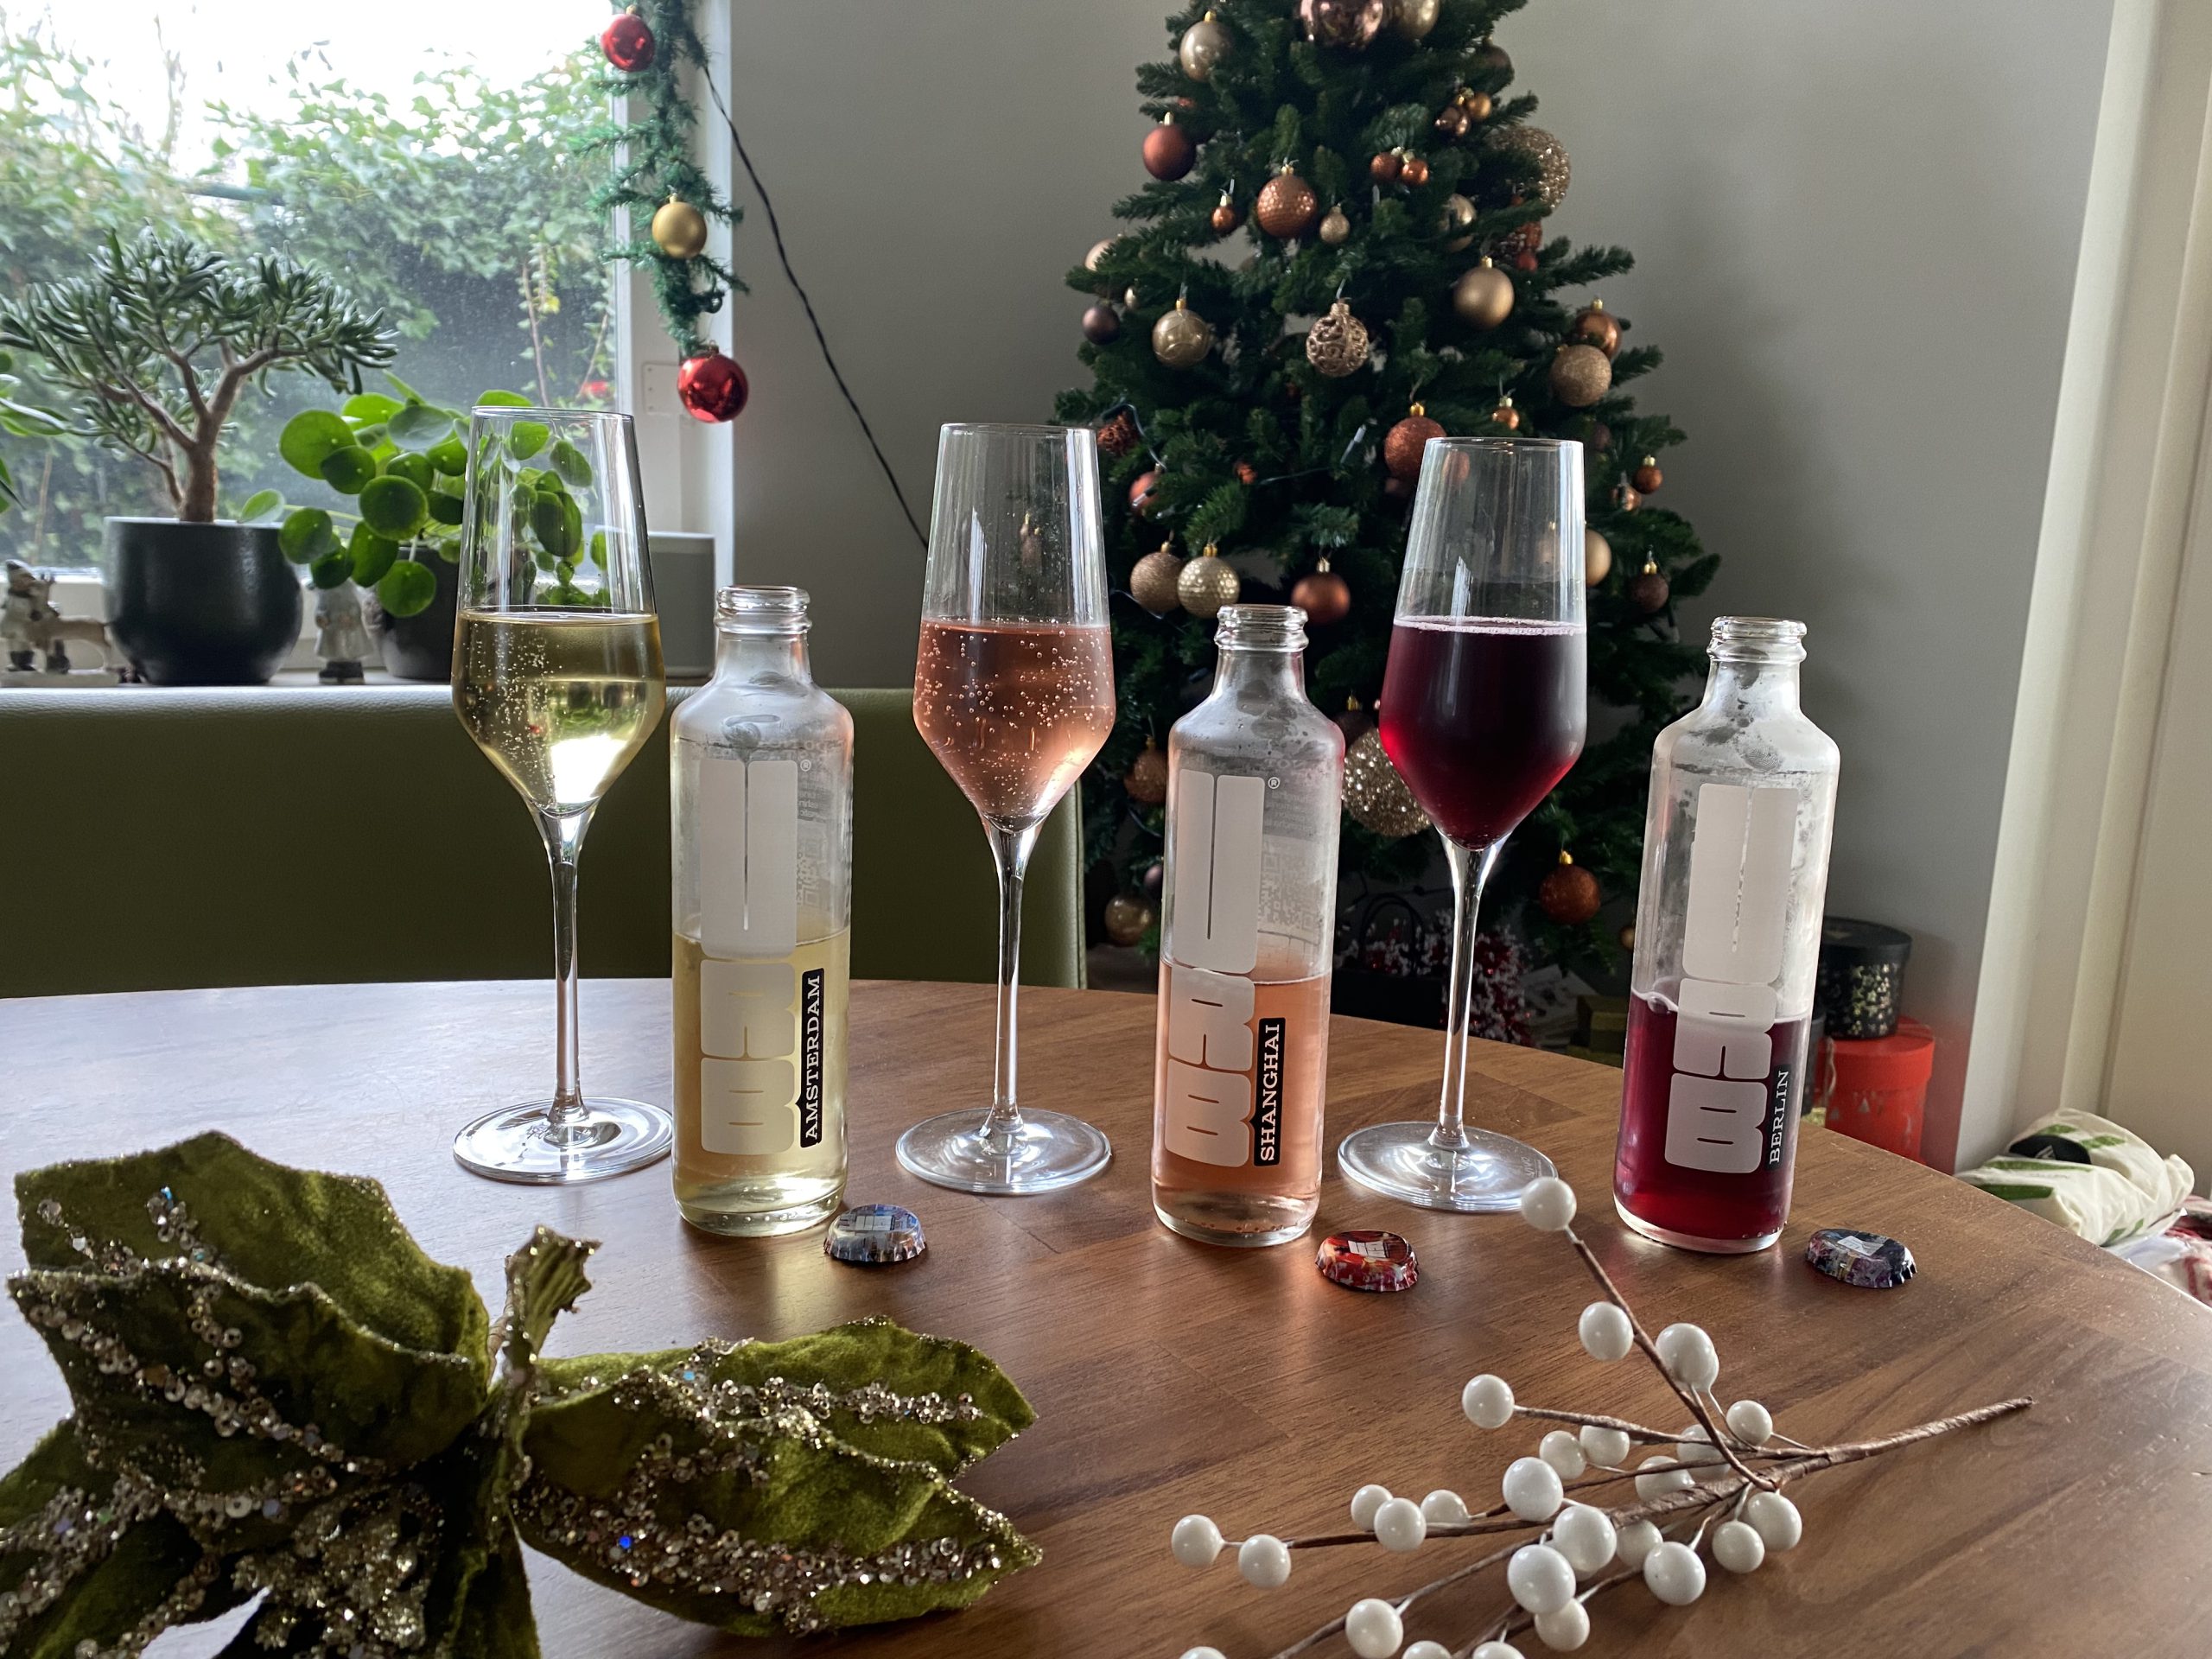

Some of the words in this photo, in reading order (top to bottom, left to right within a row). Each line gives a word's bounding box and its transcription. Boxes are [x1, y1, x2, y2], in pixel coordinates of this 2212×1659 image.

[805, 975, 820, 1141] AMSTERDAM
[1260, 1024, 1280, 1161] SHANGHAI
[1769, 1070, 1789, 1165] BERLIN
